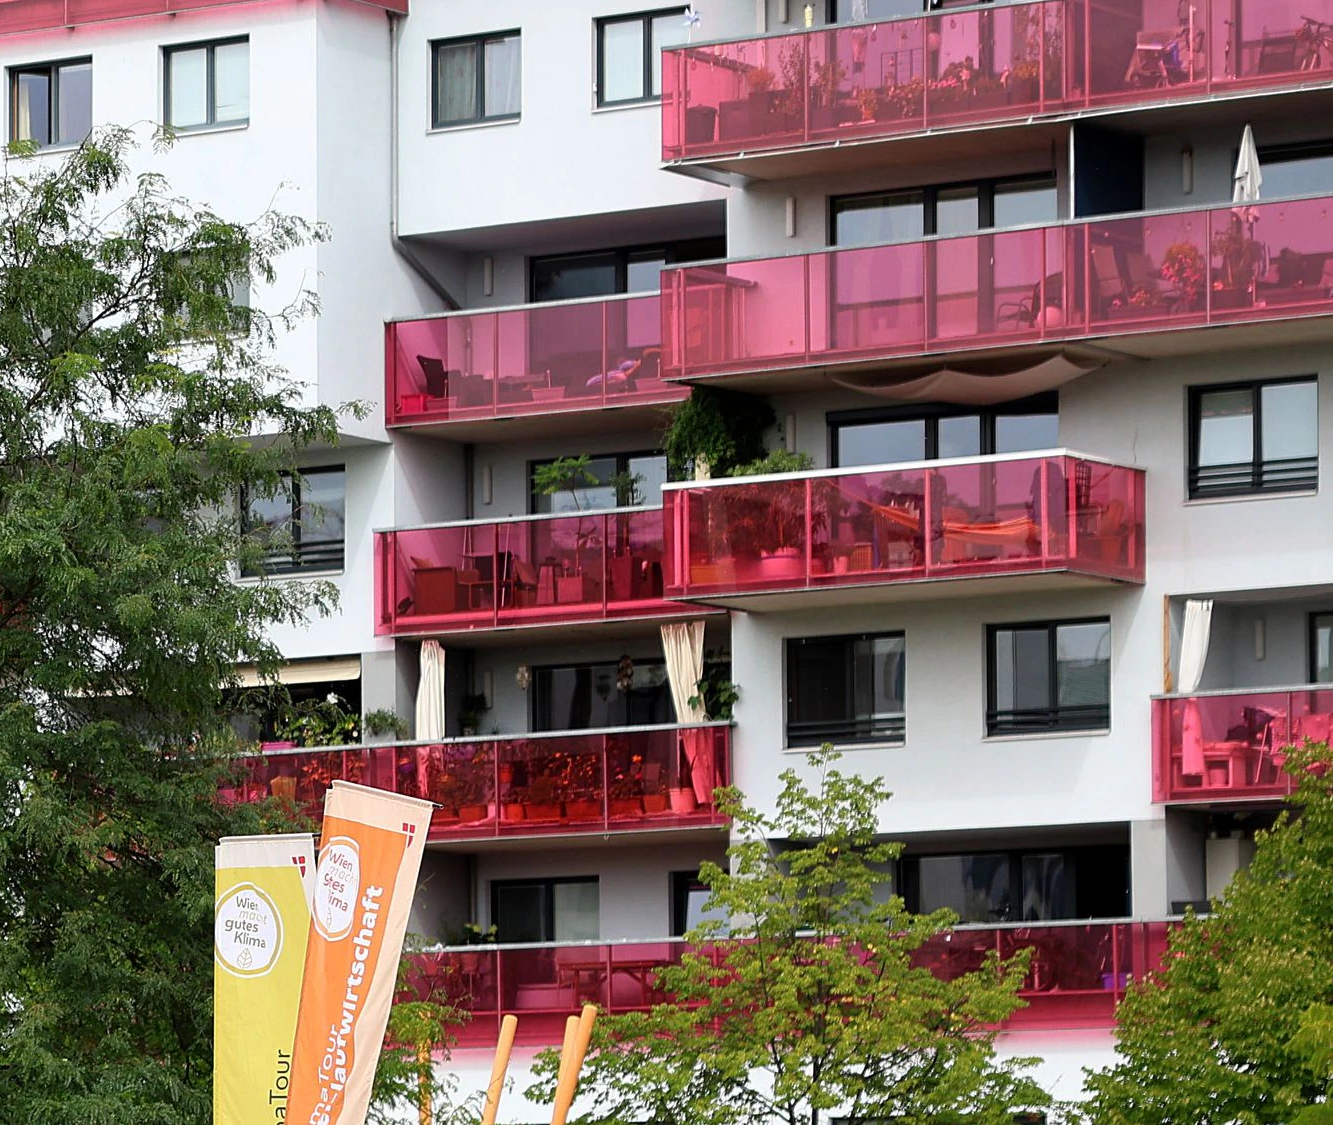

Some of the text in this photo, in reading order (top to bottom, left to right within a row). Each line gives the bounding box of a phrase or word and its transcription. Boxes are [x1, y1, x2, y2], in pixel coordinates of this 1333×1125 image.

[328, 849, 353, 871] Wien
[328, 890, 348, 912] lima
[225, 918, 259, 932] gutes
[233, 931, 267, 949] Klima
